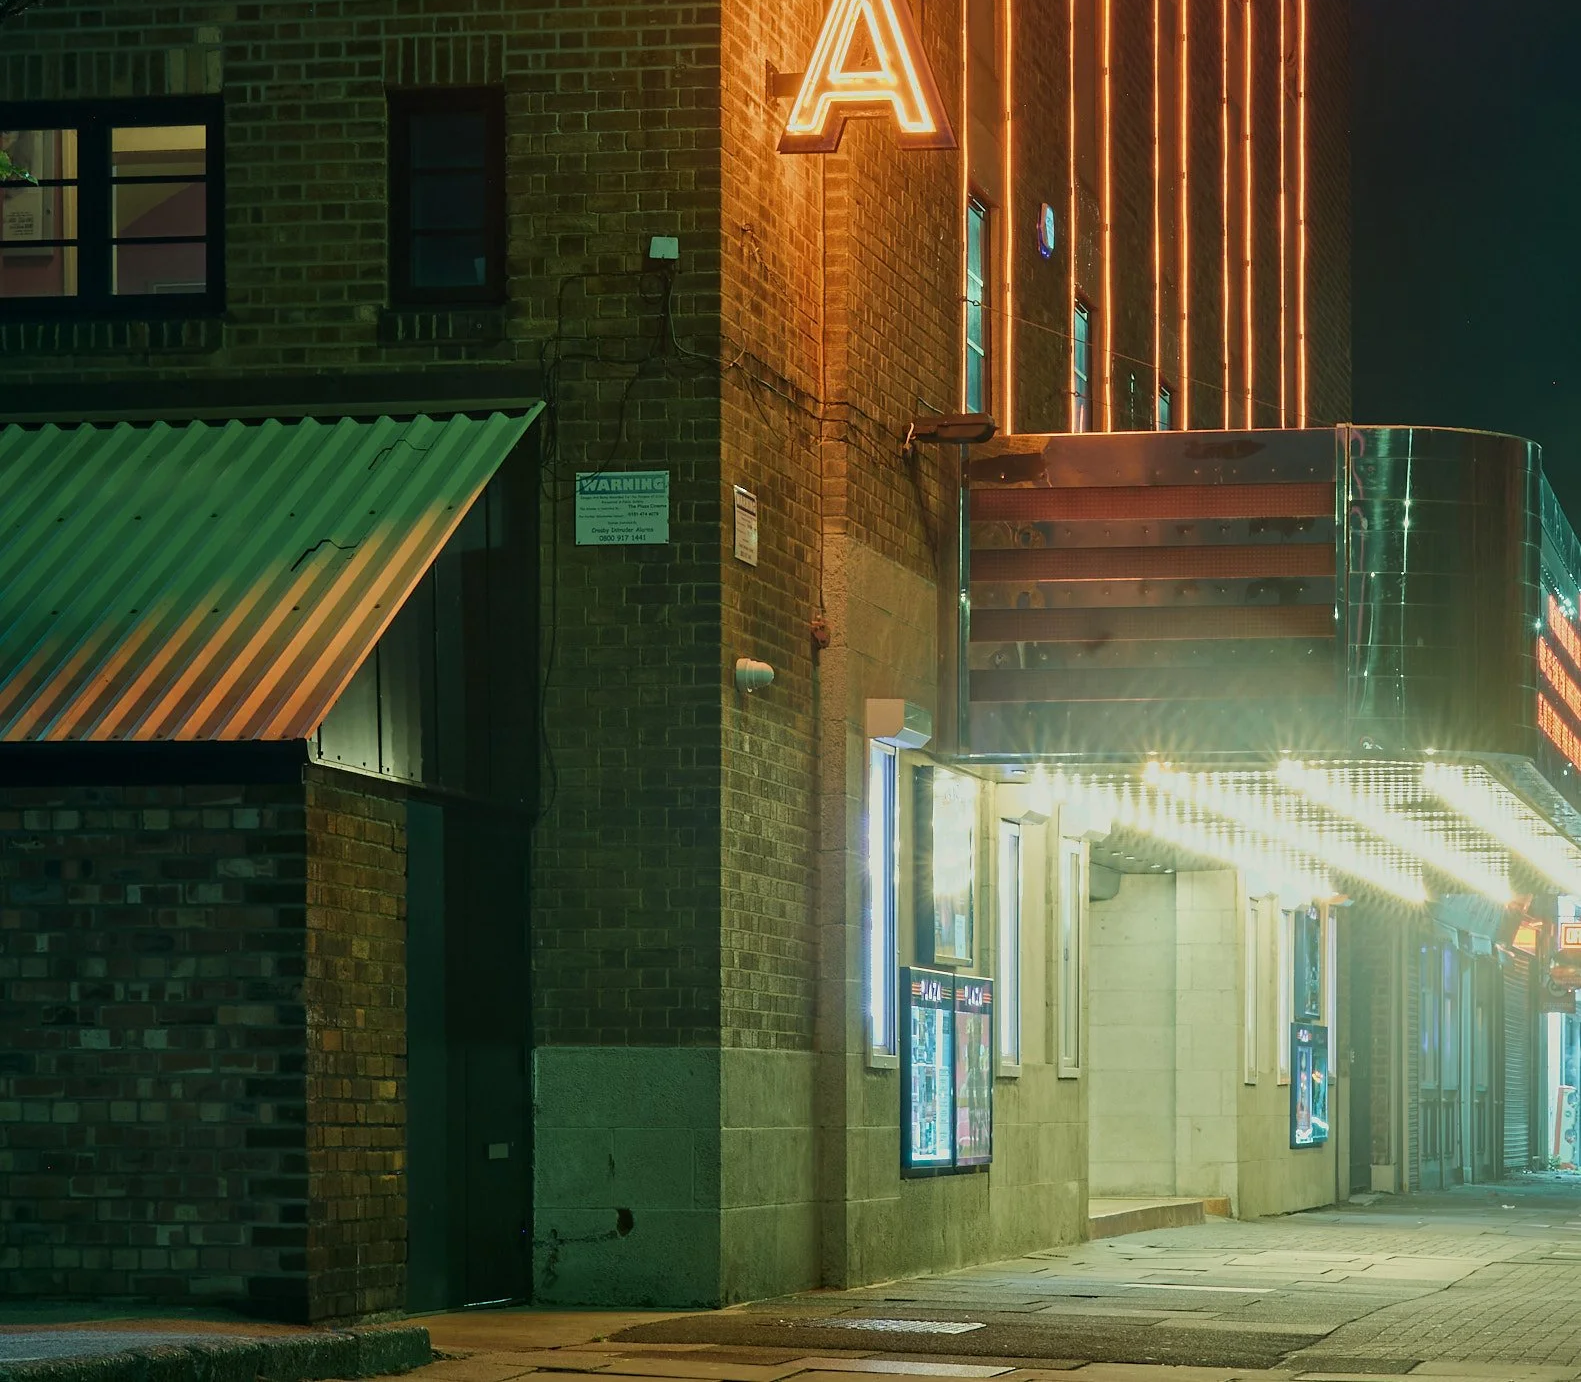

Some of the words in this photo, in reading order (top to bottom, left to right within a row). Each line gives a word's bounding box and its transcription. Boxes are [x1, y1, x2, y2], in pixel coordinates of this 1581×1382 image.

[581, 478, 664, 492] WARNING
[920, 979, 942, 1002] PLAZA
[964, 985, 983, 1006] PLAZA
